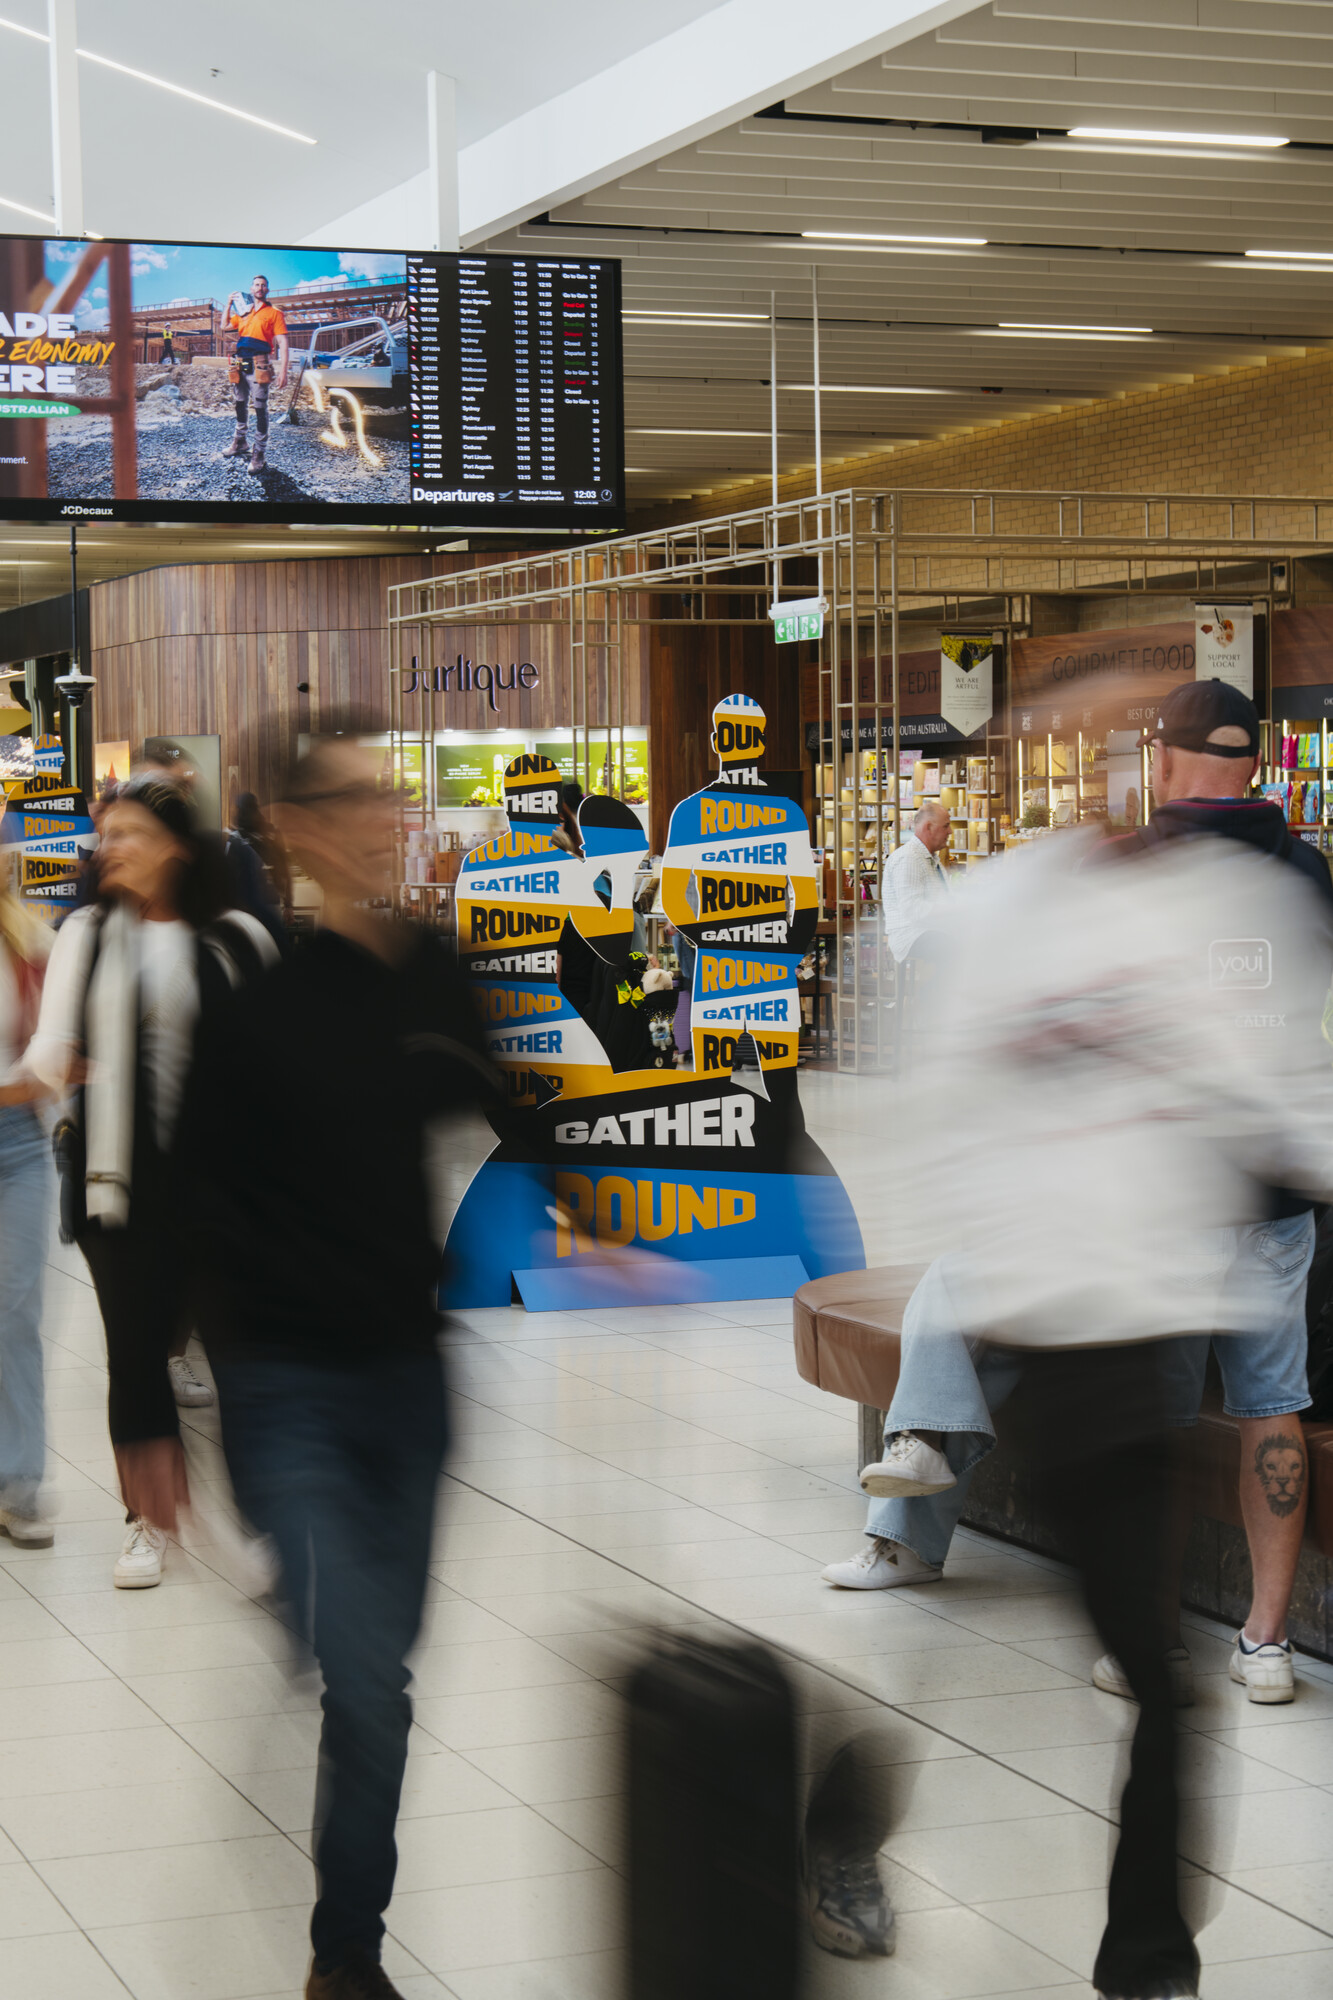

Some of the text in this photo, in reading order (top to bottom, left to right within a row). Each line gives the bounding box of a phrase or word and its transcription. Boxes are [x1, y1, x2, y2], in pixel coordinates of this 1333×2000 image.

[9, 337, 116, 369] ECONOMY
[0, 404, 69, 415] STRALIAN
[413, 488, 495, 504] Departures
[574, 491, 597, 499] 12:03
[61, 505, 114, 515] JCDecaux
[1052, 644, 1196, 681] GOURMET FOOD
[1207, 653, 1241, 667] SUPPORT
[1212, 662, 1236, 674] LOCAL
[402, 654, 539, 712] Jurlique
[843, 670, 939, 700] TE IFT EDIT
[1127, 707, 1156, 720] BEST OF
[899, 723, 917, 736] OUTH
[918, 723, 948, 735] AUSTRALIA
[24, 776, 74, 795] ROUN
[24, 797, 75, 812] GATHER
[700, 797, 787, 836] ROUND
[24, 816, 76, 838] ROUND
[25, 840, 76, 854] GATHER
[701, 842, 787, 866] GATHER
[26, 858, 77, 881] ROUND
[26, 882, 77, 897] GATHER
[470, 870, 560, 894] GATHER
[701, 876, 786, 914] ROUND
[470, 905, 561, 944] ROUND
[701, 920, 788, 944] GATHER
[470, 949, 558, 974] GATHER
[1217, 948, 1263, 981] youi
[702, 955, 788, 994] ROUND
[703, 998, 788, 1022] GATHER
[488, 1029, 563, 1054] ATHER
[703, 1034, 789, 1072] ROND
[555, 1093, 756, 1147] GATHER
[555, 1171, 757, 1258] ROUND
